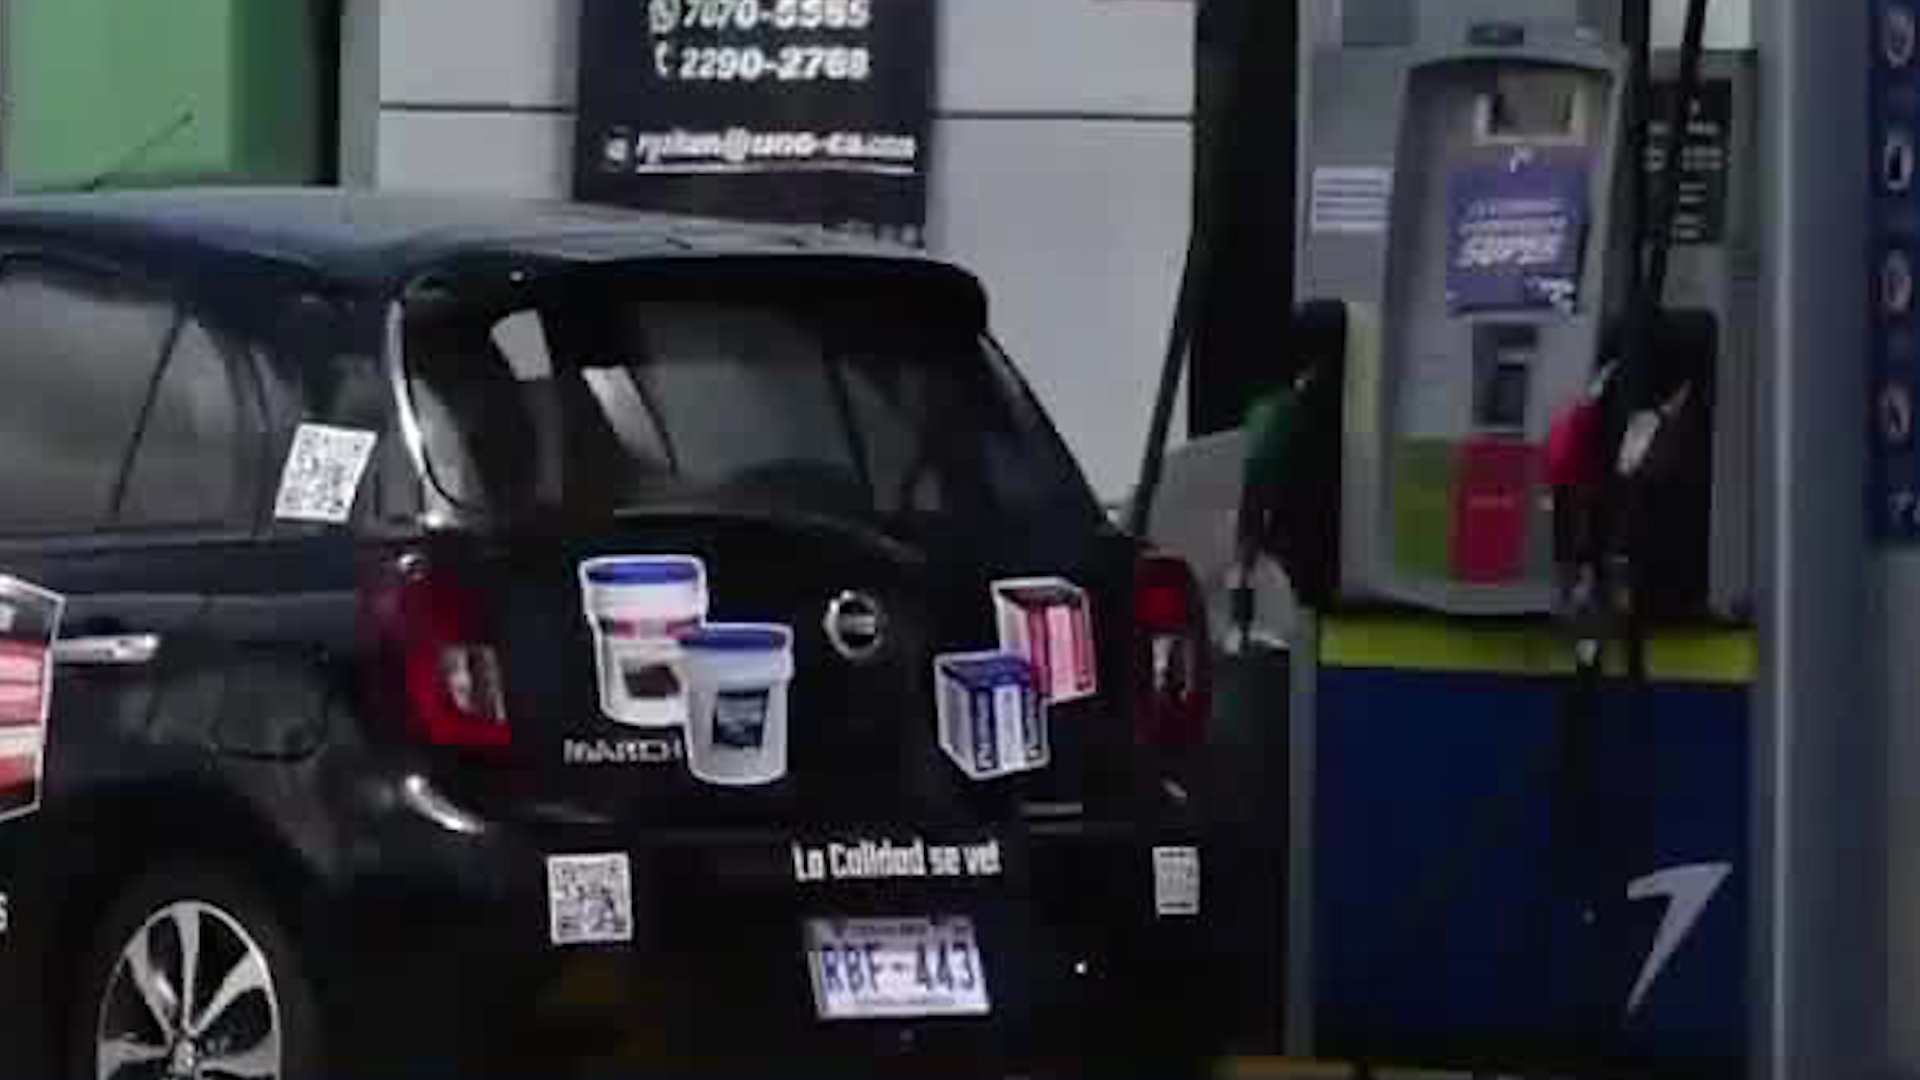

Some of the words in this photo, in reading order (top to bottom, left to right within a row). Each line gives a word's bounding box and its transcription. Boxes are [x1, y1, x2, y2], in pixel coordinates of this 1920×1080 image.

[828, 837, 926, 878] Calidad
[928, 845, 961, 876] se
[821, 941, 976, 992] RBF-443
